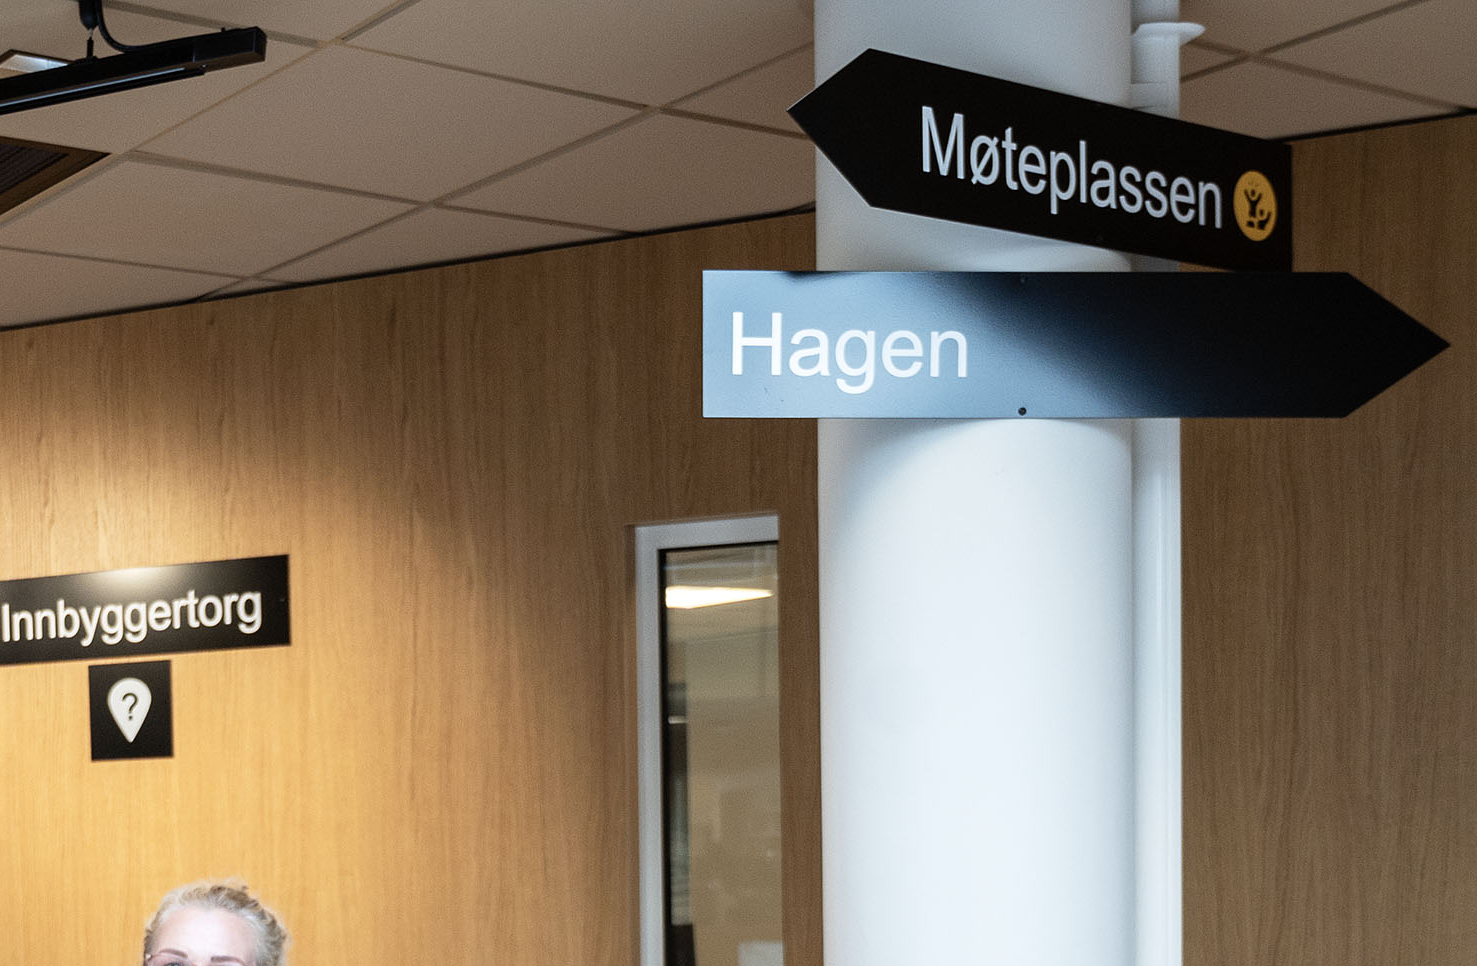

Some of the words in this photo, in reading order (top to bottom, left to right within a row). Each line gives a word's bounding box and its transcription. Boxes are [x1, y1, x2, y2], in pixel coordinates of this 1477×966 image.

[920, 104, 1225, 231] Møteplassen
[729, 310, 970, 394] Hagen
[0, 589, 264, 648] Innbyggertorg
